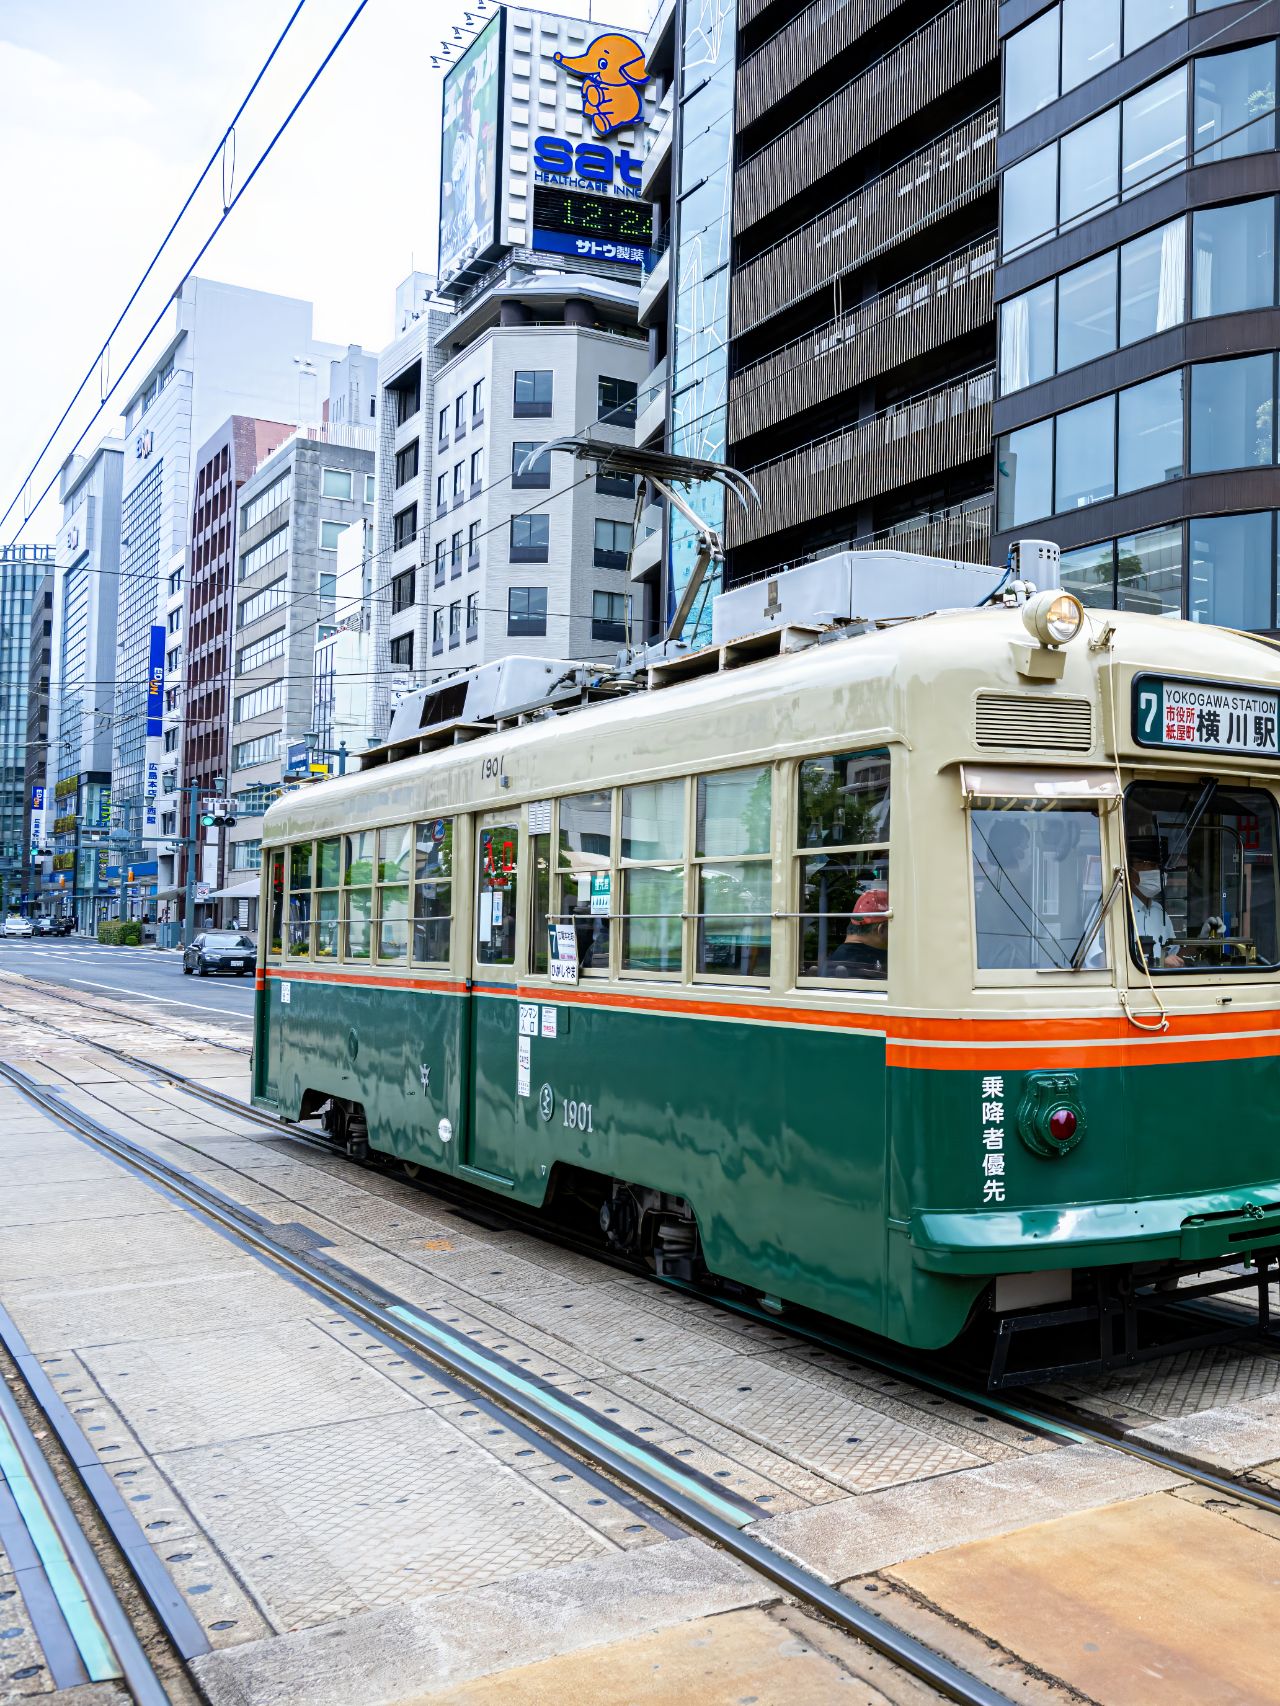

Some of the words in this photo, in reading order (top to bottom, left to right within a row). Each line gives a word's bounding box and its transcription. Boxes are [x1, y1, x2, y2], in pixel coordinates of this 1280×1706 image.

[534, 170, 608, 193] HEALTHCARE
[575, 239, 645, 262] サトウ製薬
[1140, 692, 1158, 733] 7
[1165, 689, 1230, 709] YOKOGAWA
[1231, 696, 1277, 715] STATION
[1165, 705, 1195, 723] 市役所
[1165, 722, 1196, 742] 紙屋町
[1196, 708, 1277, 748] 横川駅
[481, 754, 504, 780] 1901
[483, 841, 513, 873] 入口
[549, 931, 557, 953] 7
[551, 964, 576, 979] ひがしやま
[520, 1006, 538, 1019] ワンマン
[563, 1098, 593, 1133] 1901
[981, 1075, 1006, 1203] 乗降者優先
